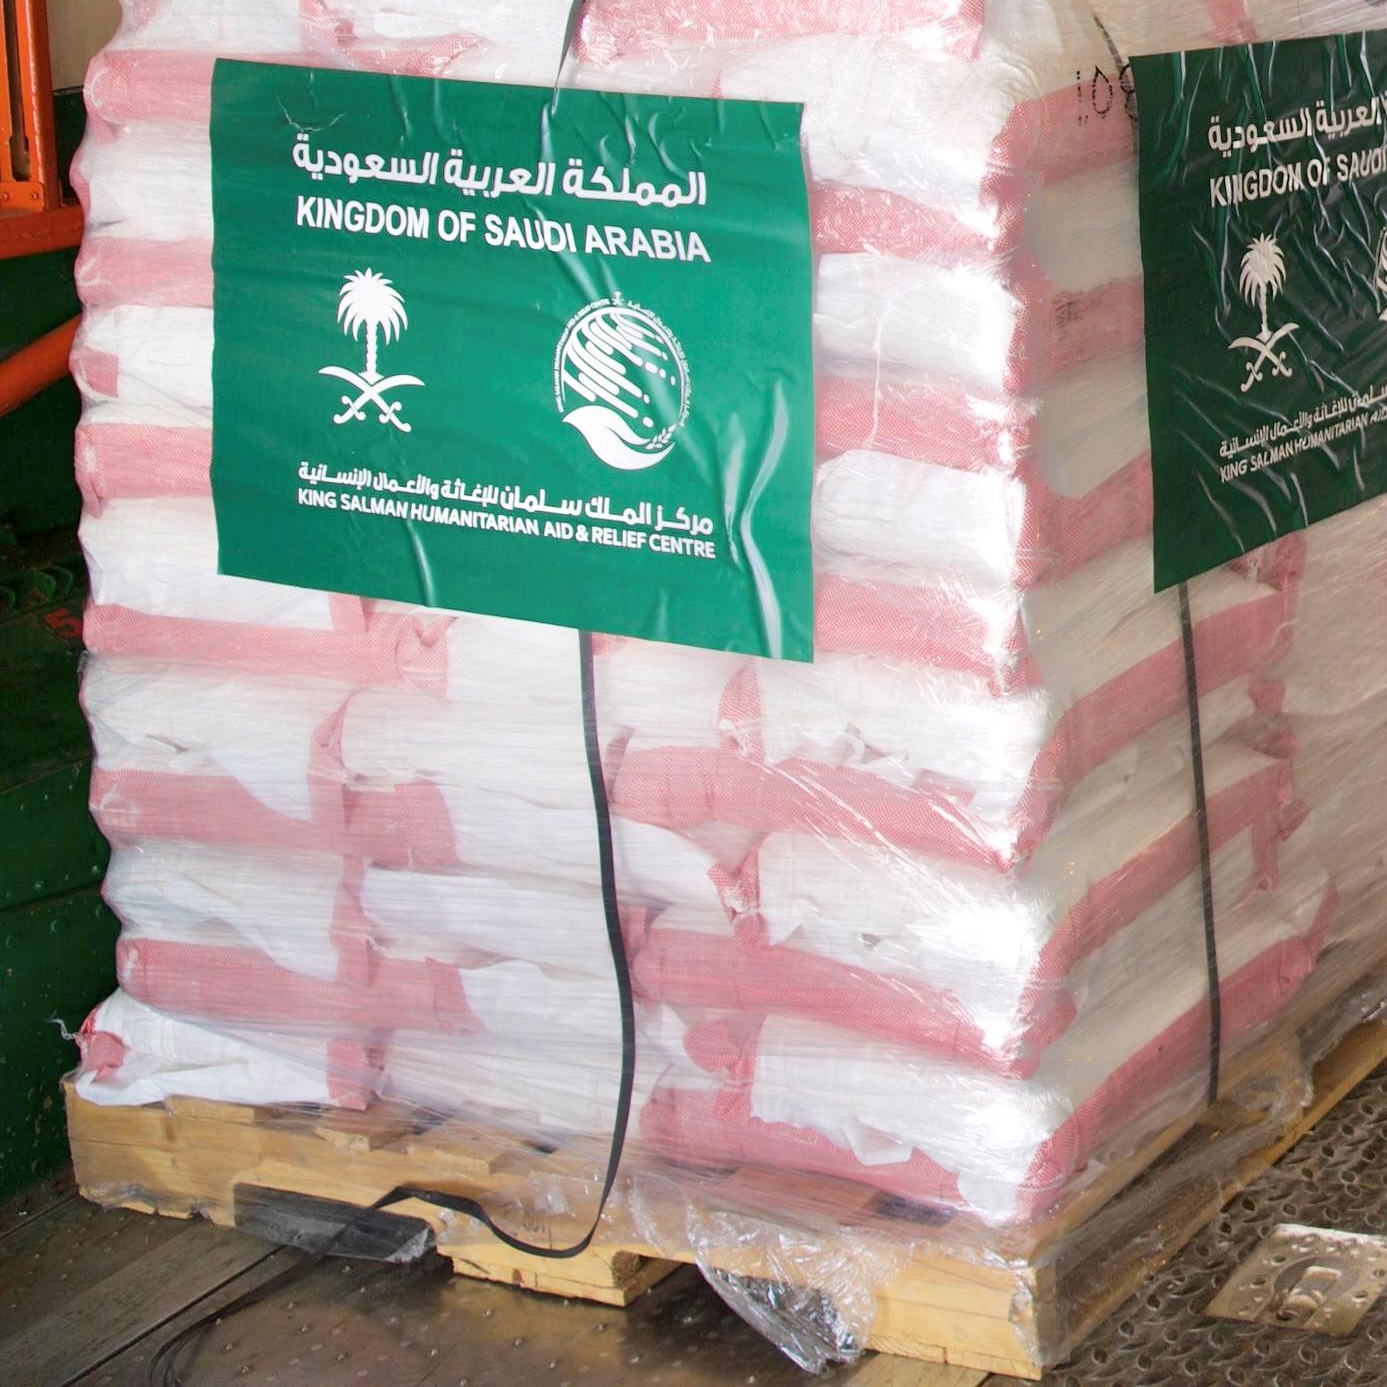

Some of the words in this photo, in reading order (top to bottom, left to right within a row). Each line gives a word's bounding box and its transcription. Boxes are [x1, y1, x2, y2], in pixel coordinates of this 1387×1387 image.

[1208, 106, 1312, 158] السعودية
[1316, 96, 1382, 139] العربية
[292, 133, 439, 185] السعودية
[444, 148, 556, 198] العربية
[563, 158, 707, 208] المملكة
[1209, 162, 1303, 209] KINGDOM
[1306, 155, 1330, 188] OF
[1336, 143, 1387, 183] SAUDI
[296, 195, 430, 239] KINGDOM
[437, 210, 477, 244] OF
[484, 213, 577, 254] SAUDI
[584, 224, 712, 264] ARABIA
[1220, 458, 1248, 483] KING
[1249, 440, 1294, 472] SALMAN
[1294, 411, 1369, 454] HUMANITARIAN
[298, 487, 338, 509] KING
[340, 493, 409, 519] SALMAN
[410, 502, 540, 537] HUMANITARIAN
[543, 520, 574, 540] AID
[575, 524, 589, 543] &
[591, 526, 647, 550] RELIEF
[648, 533, 716, 559] CENTRE
[499, 484, 583, 517] سلمان
[585, 495, 652, 526] الملك
[654, 504, 714, 536] مركز
